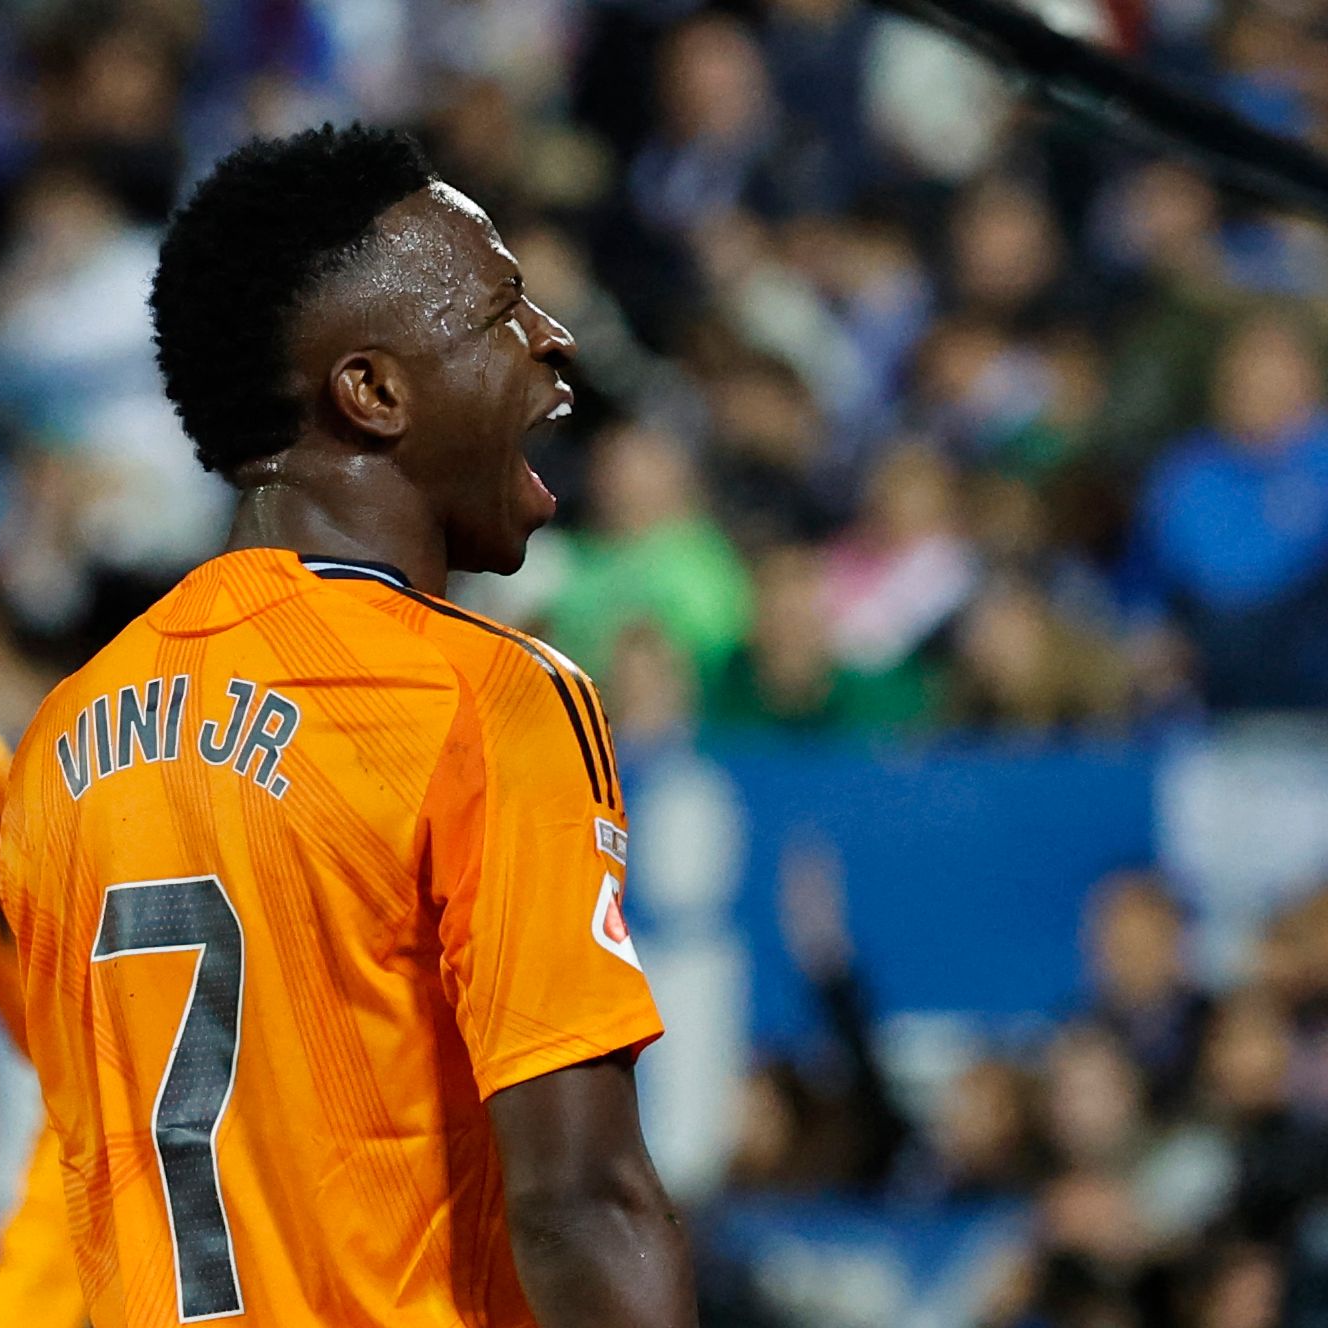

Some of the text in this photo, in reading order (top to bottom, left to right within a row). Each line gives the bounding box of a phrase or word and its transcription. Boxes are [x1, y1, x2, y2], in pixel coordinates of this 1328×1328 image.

[56, 674, 301, 800] VINI JR.
[91, 874, 244, 1324] 7
